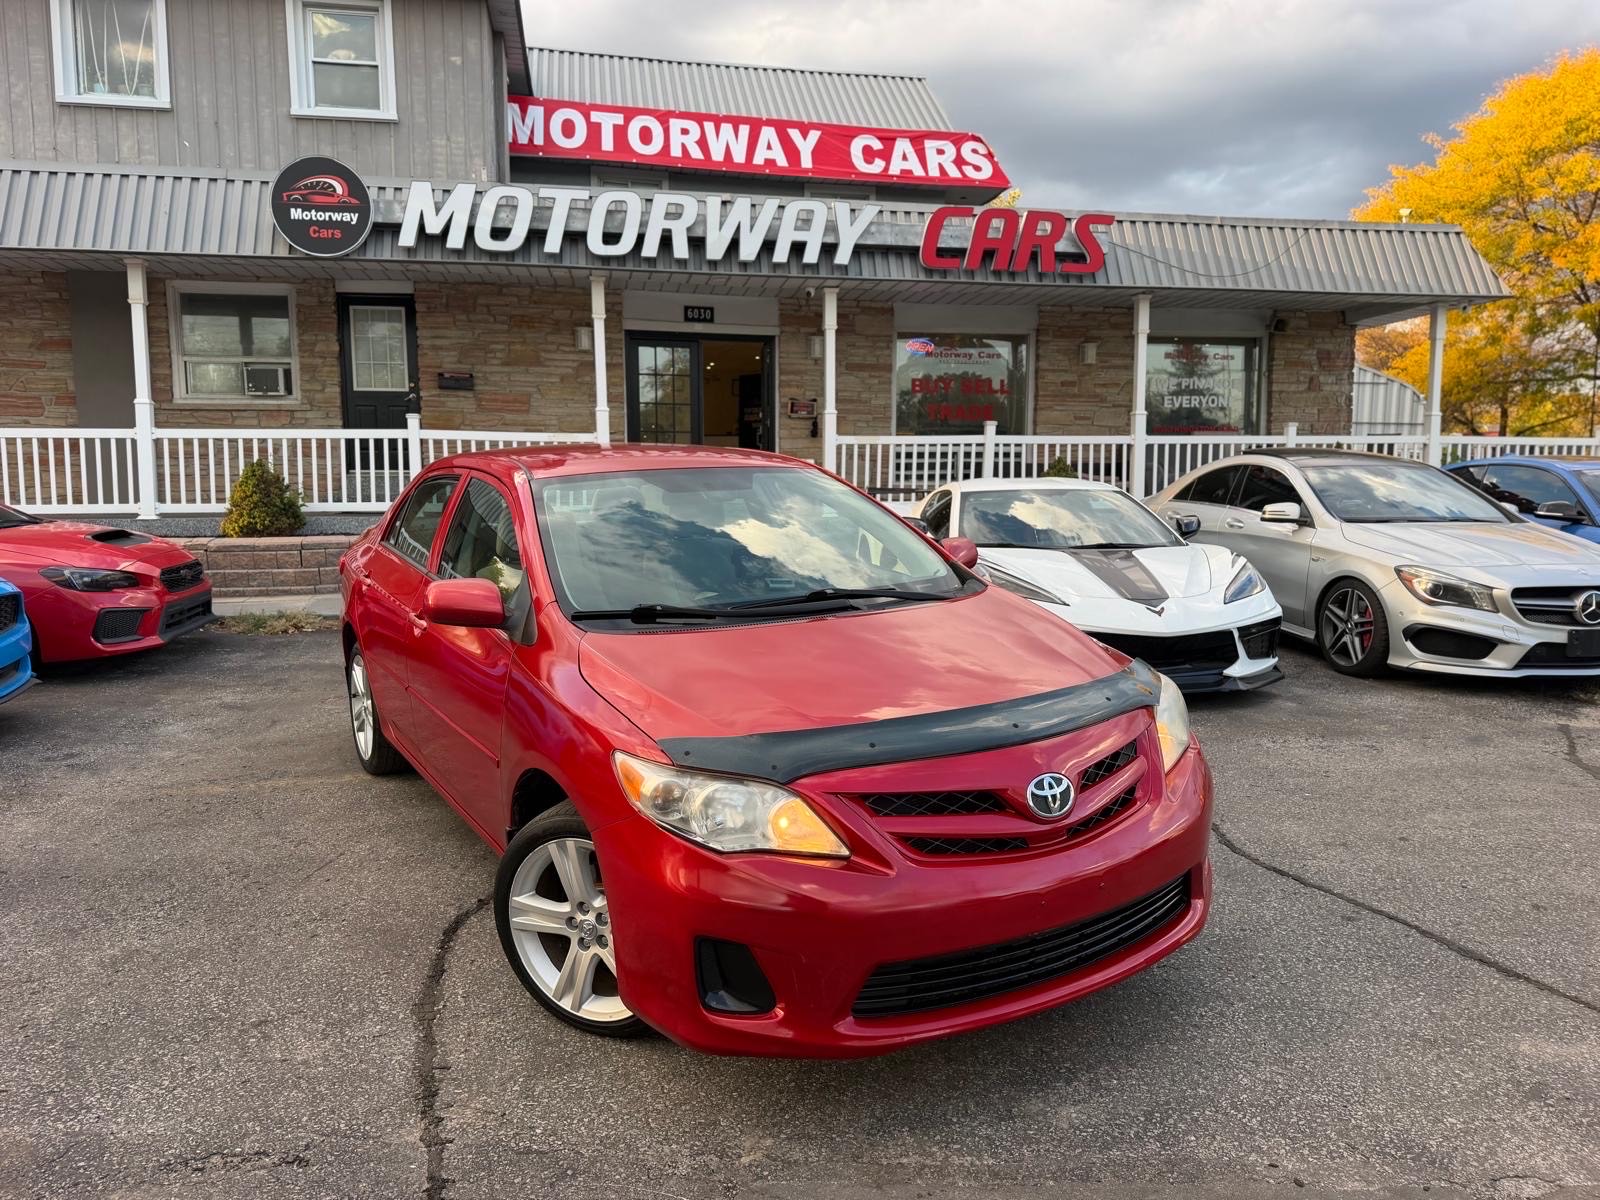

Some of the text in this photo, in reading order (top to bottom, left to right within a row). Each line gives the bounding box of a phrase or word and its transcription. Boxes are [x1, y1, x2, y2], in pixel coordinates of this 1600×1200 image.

[507, 102, 994, 180] MOTORWAY CARS
[290, 207, 359, 225] Motorway
[309, 225, 342, 239] Cars
[398, 180, 1115, 274] MOTORWAY CARS
[687, 308, 712, 320] 6030
[925, 351, 1002, 360] Motorway Cars
[1213, 353, 1235, 361] Cars
[911, 378, 1011, 395] BUY SELL
